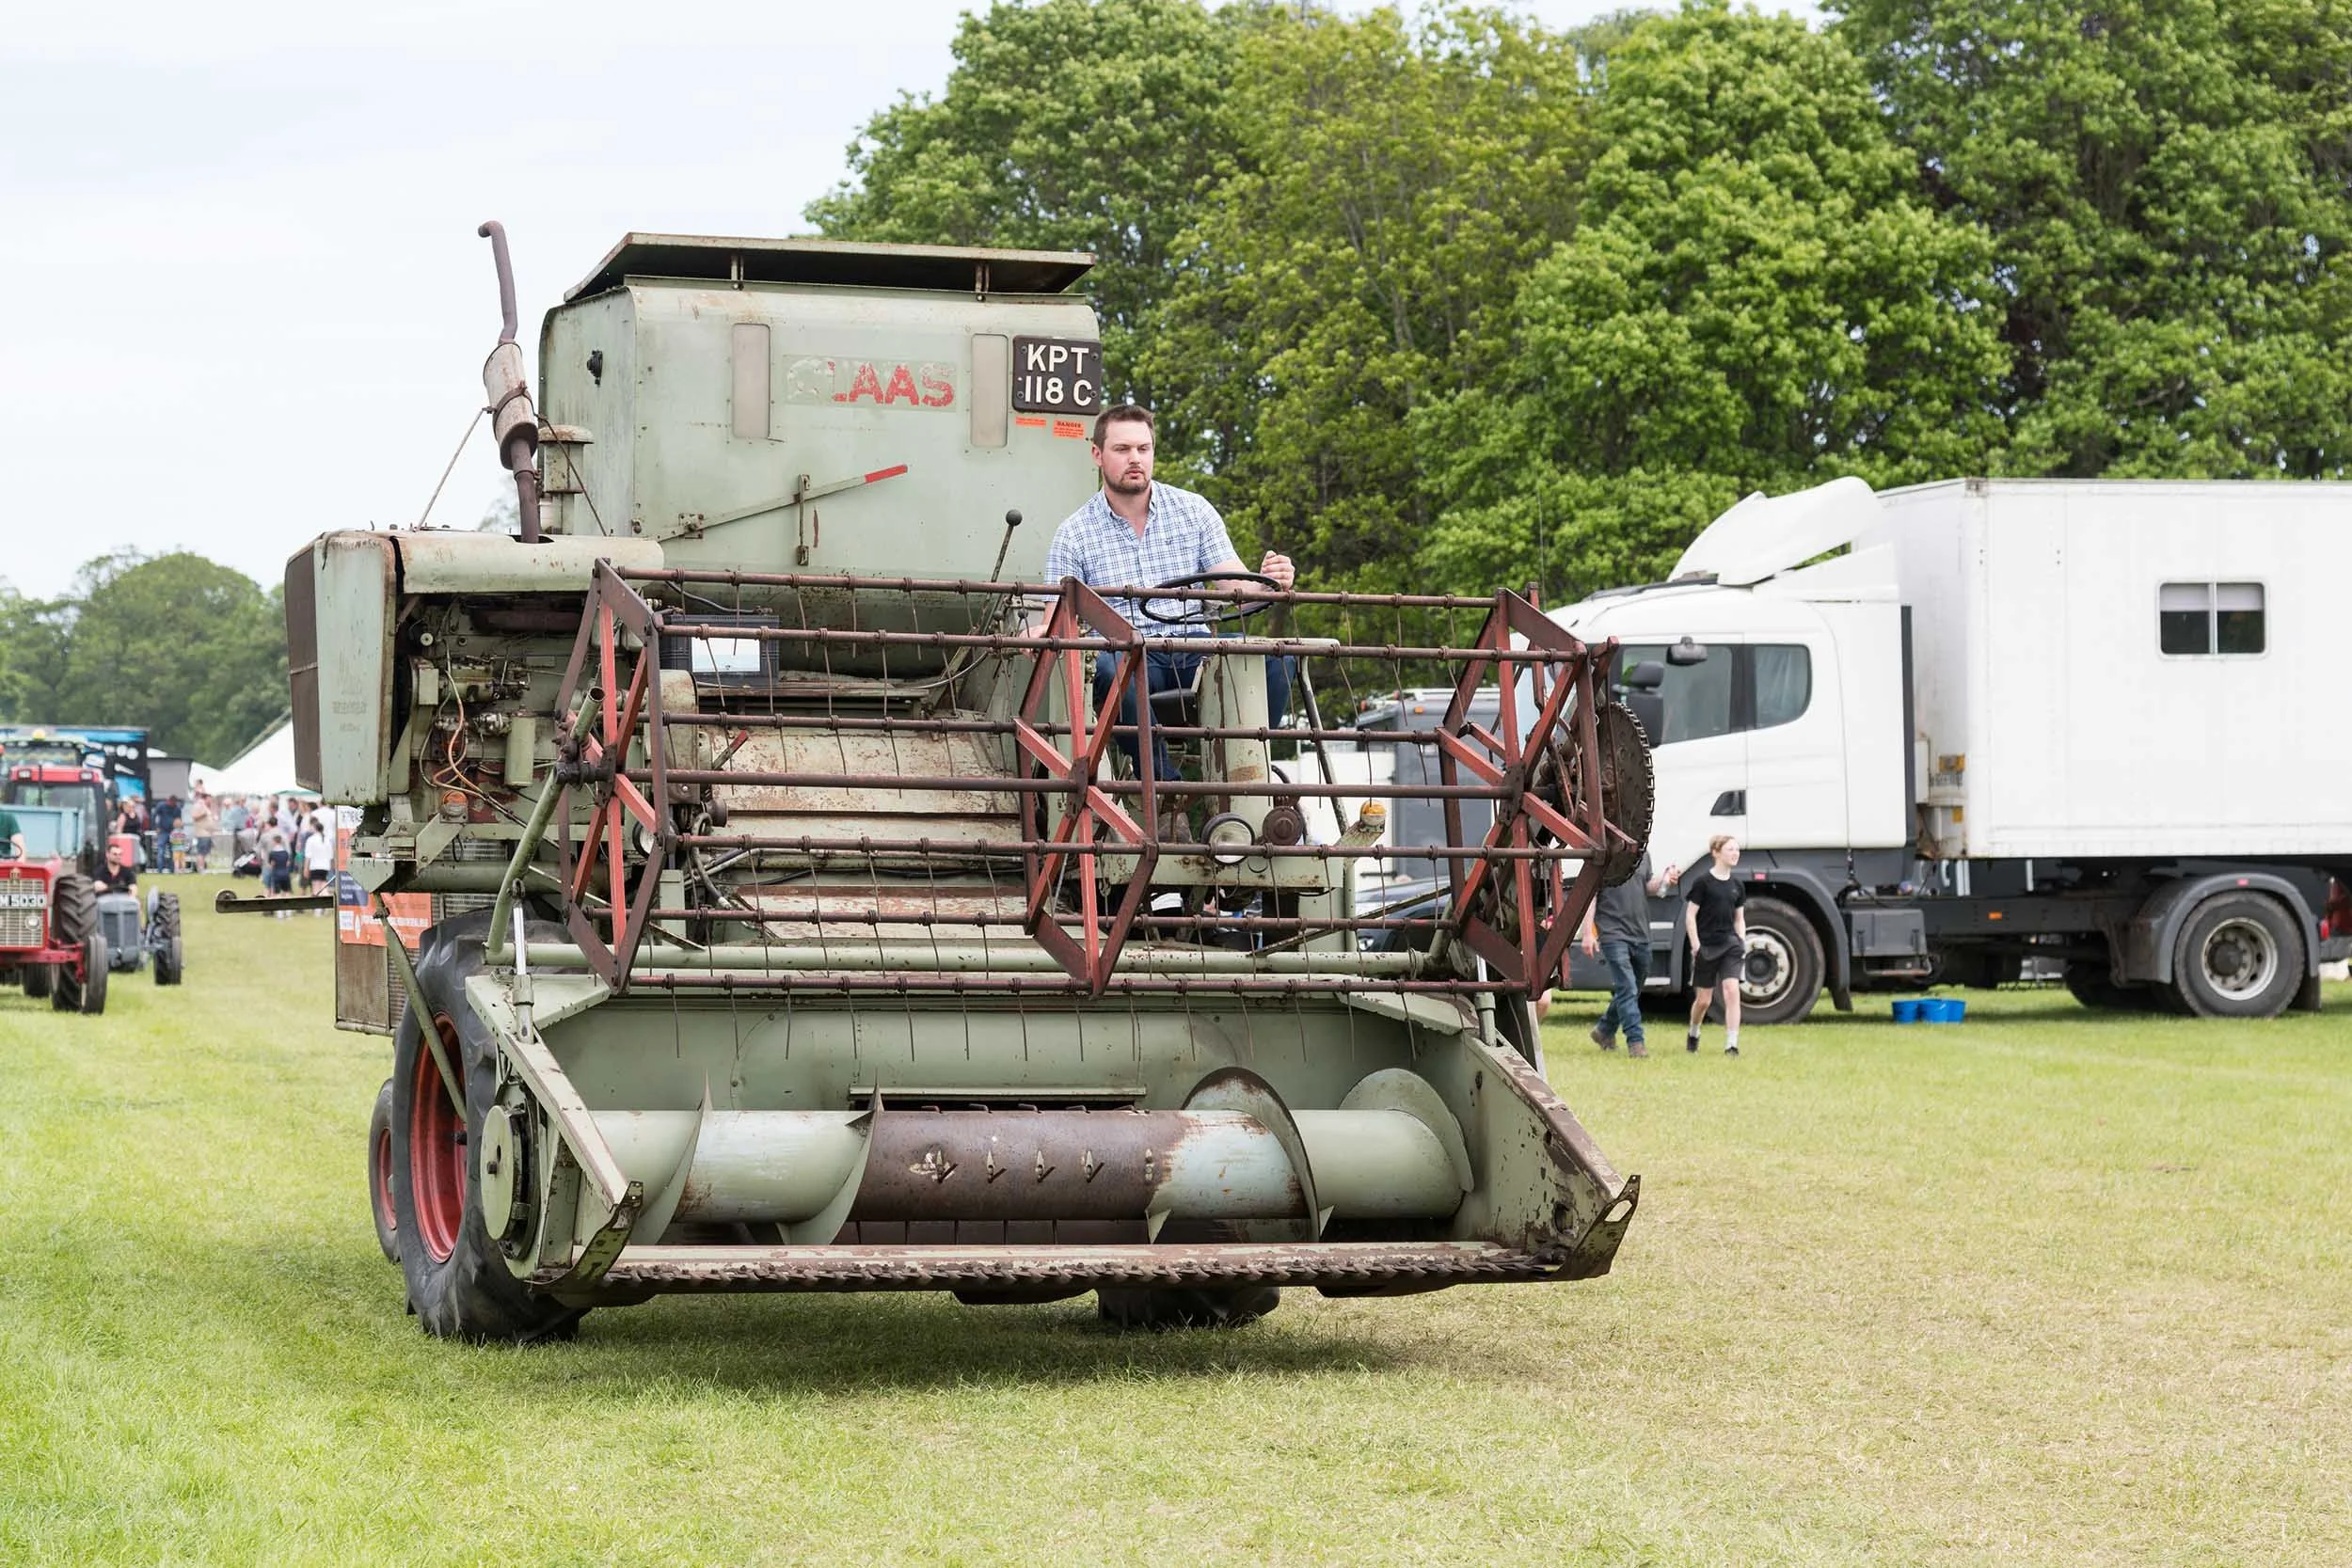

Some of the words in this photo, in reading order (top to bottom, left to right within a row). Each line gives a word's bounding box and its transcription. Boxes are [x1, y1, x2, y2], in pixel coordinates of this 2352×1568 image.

[1027, 343, 1089, 374] KPT
[1025, 375, 1064, 404] 118
[1073, 379, 1092, 406] C
